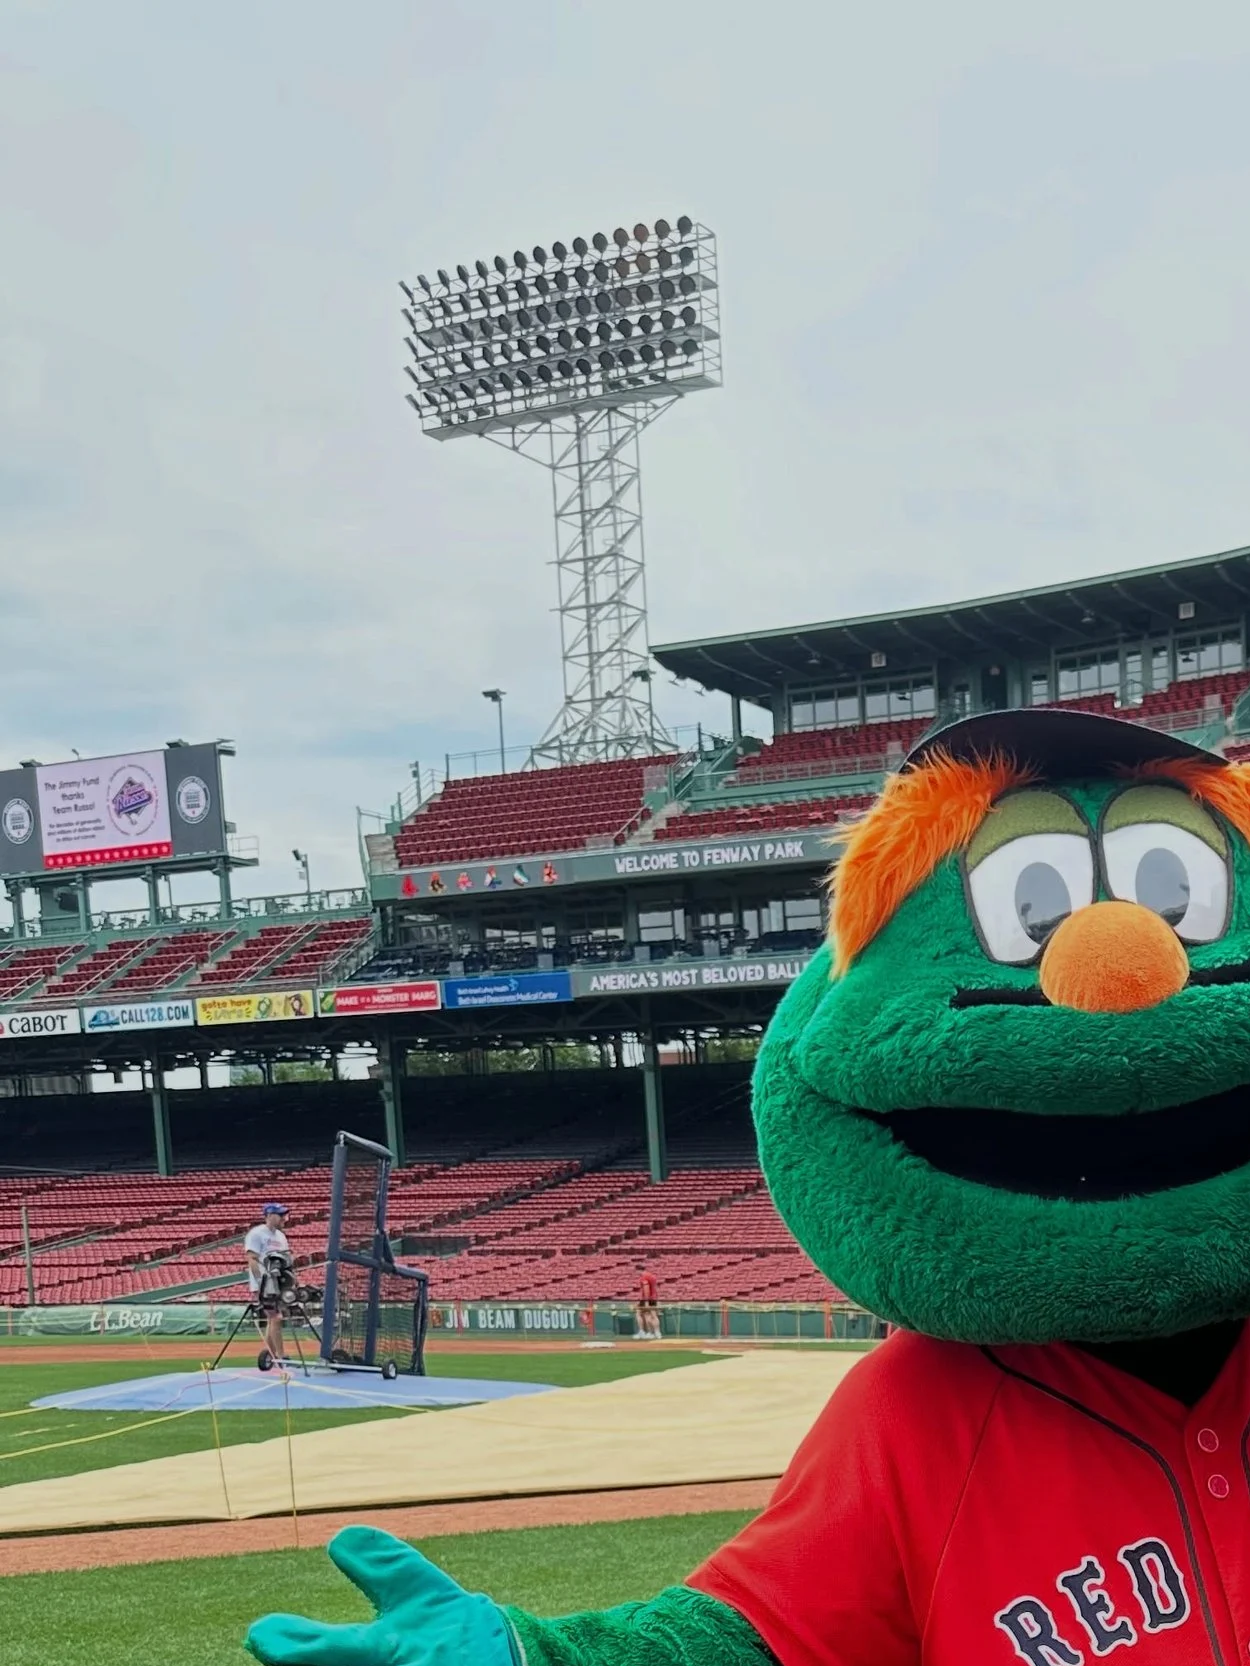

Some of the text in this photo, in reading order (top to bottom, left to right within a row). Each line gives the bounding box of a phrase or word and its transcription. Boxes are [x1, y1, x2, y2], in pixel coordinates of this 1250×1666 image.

[44, 781, 56, 791] The
[61, 792, 85, 801] thanks
[615, 841, 804, 873] WELCOME TO FENWAY PARK
[590, 962, 809, 991] AMERICA'S MOST BELOVED BALL
[121, 1005, 190, 1024] CALL128.COM
[90, 1309, 163, 1331] LL.Bean
[446, 1308, 576, 1329] JIM BEAM DUGOUT
